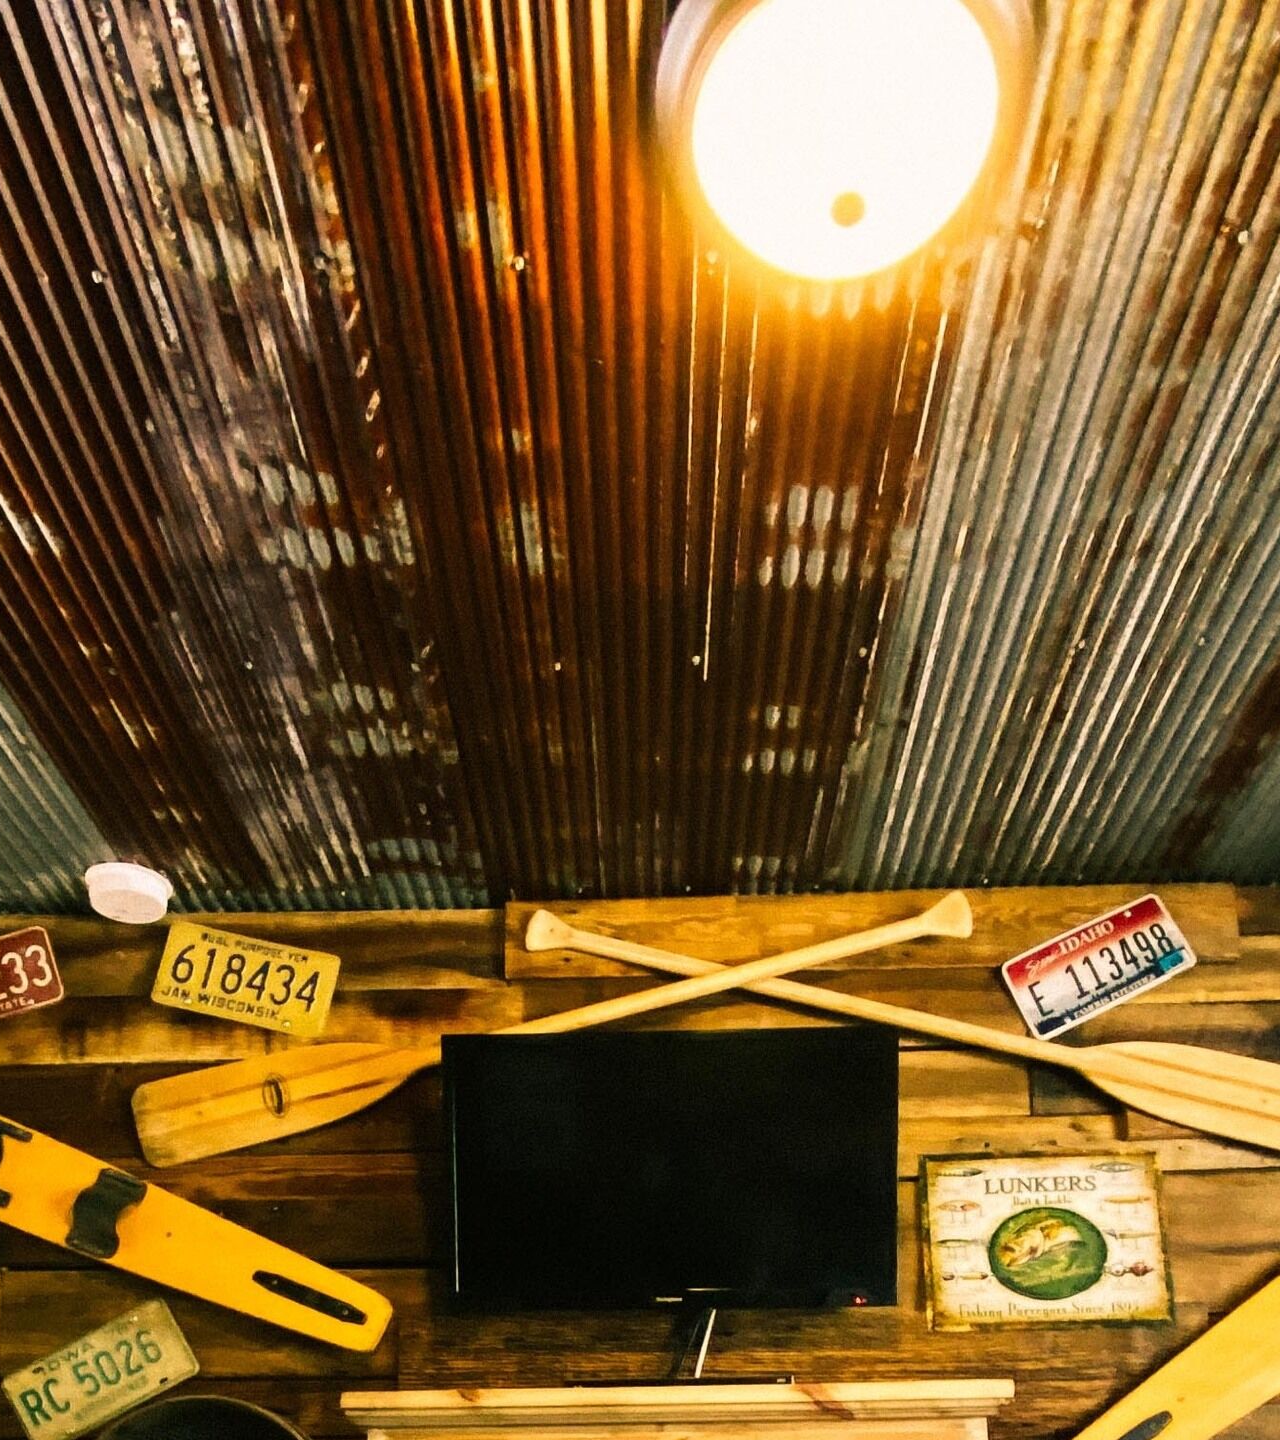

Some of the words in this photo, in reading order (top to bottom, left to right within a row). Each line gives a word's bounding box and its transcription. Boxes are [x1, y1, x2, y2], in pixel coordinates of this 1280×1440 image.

[1057, 920, 1115, 954] IDAHO
[171, 944, 321, 1013] 618434
[1027, 980, 1054, 1017] E
[1065, 922, 1176, 1000] 113498
[161, 986, 191, 1001] JAN
[197, 992, 281, 1021] WISCONSIN
[983, 1175, 1098, 1195] LUNKERS
[19, 1377, 71, 1427] RC
[72, 1329, 163, 1397] 5026
